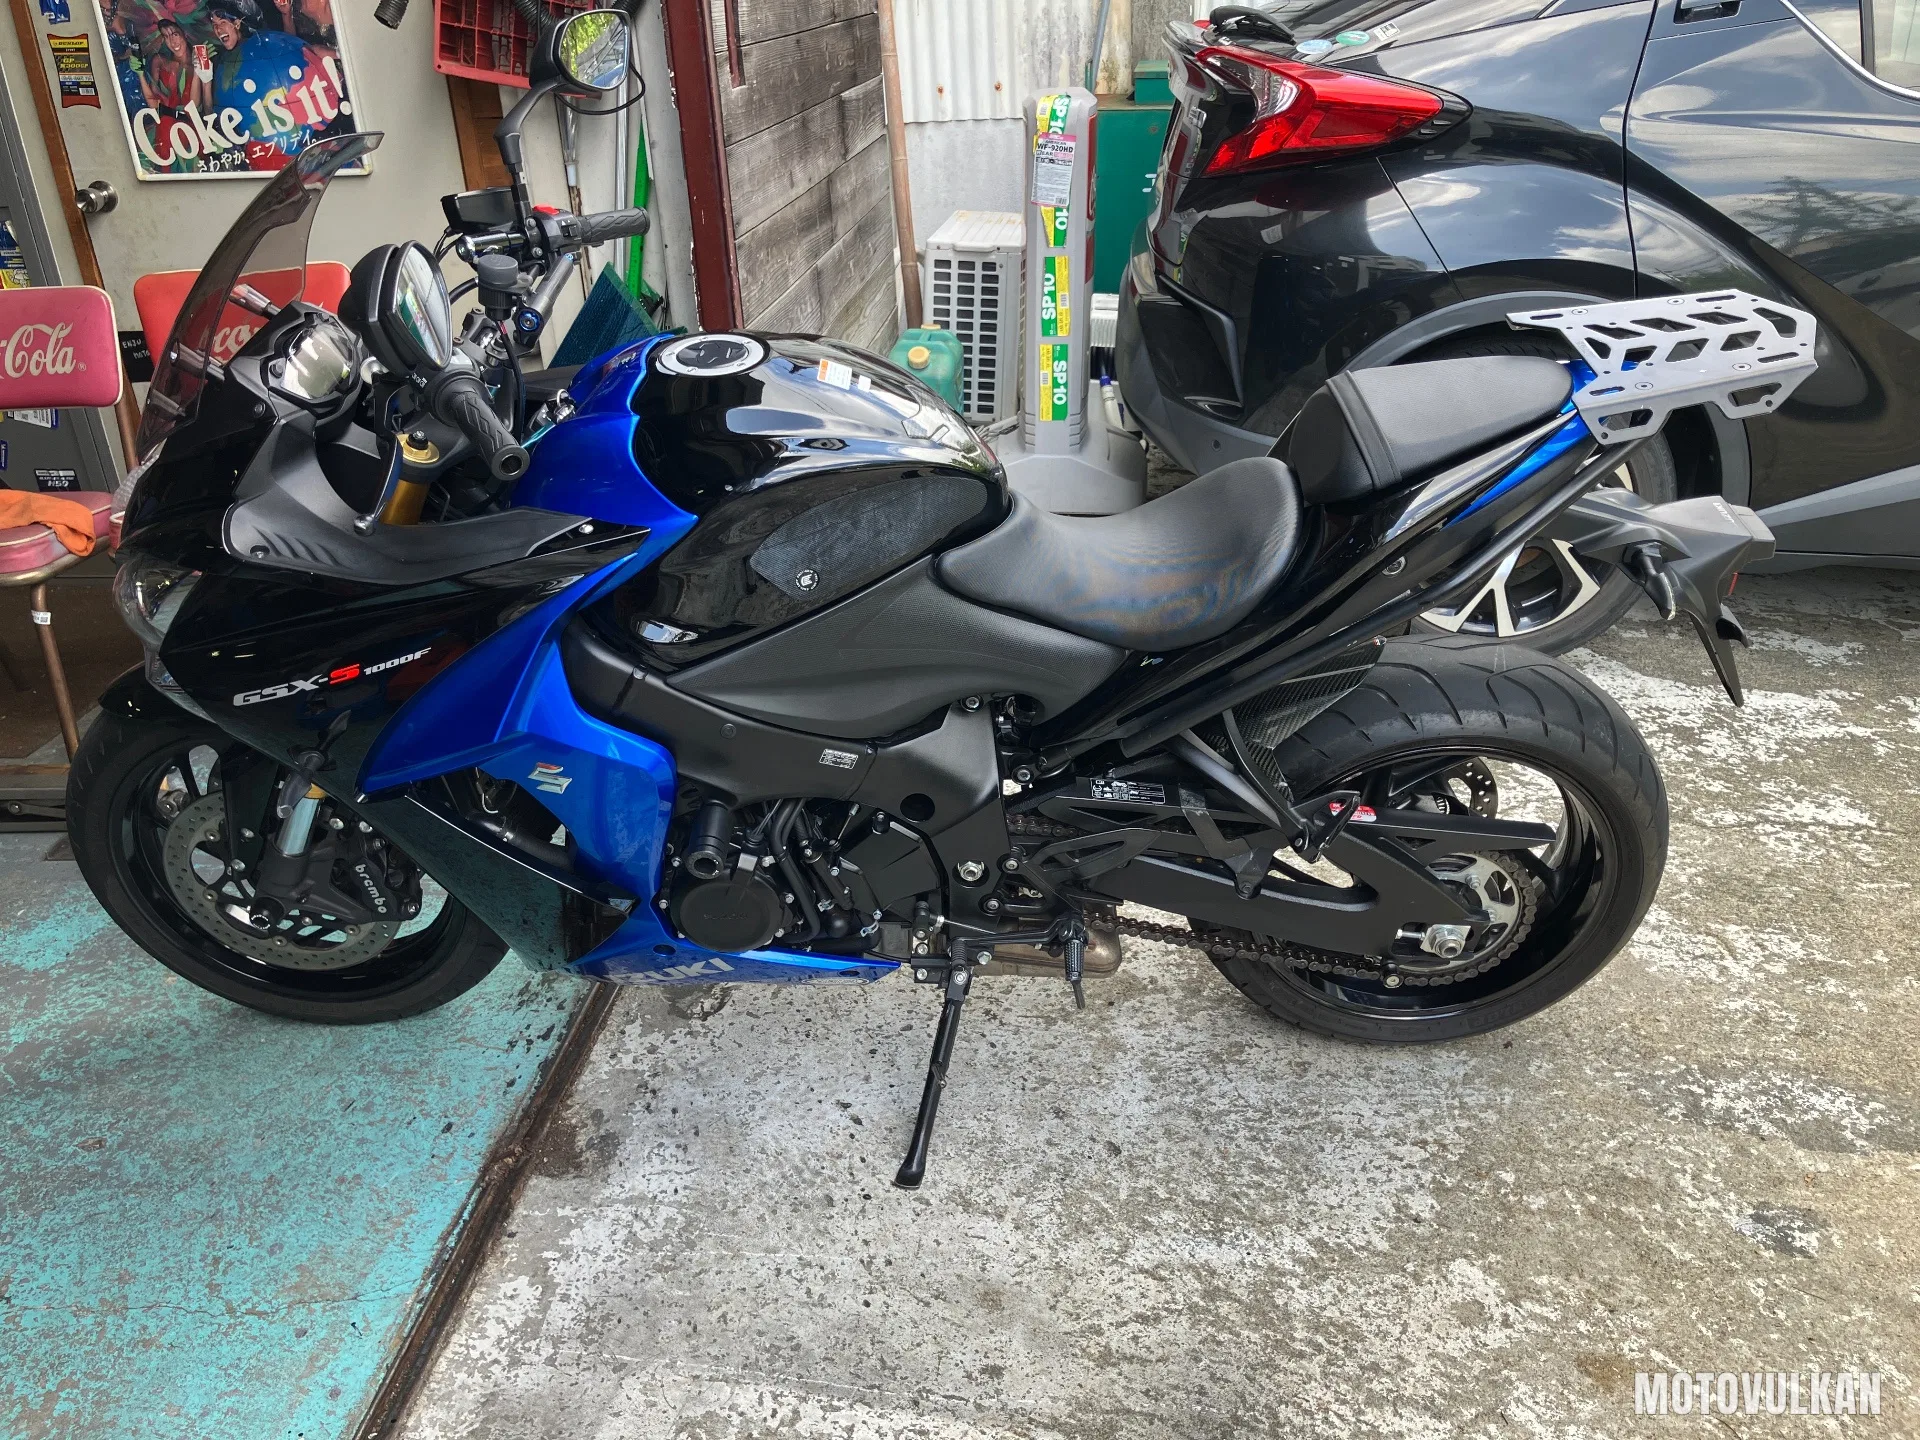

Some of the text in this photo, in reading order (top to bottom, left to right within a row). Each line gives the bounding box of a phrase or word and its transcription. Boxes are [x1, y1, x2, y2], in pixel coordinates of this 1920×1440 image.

[133, 55, 353, 167] Coke is it!
[1037, 143, 1074, 153] WF-920HD
[1041, 273, 1057, 320] SP10
[1053, 360, 1067, 405] SP10
[363, 647, 432, 676] 1000F
[355, 863, 387, 914] brembo
